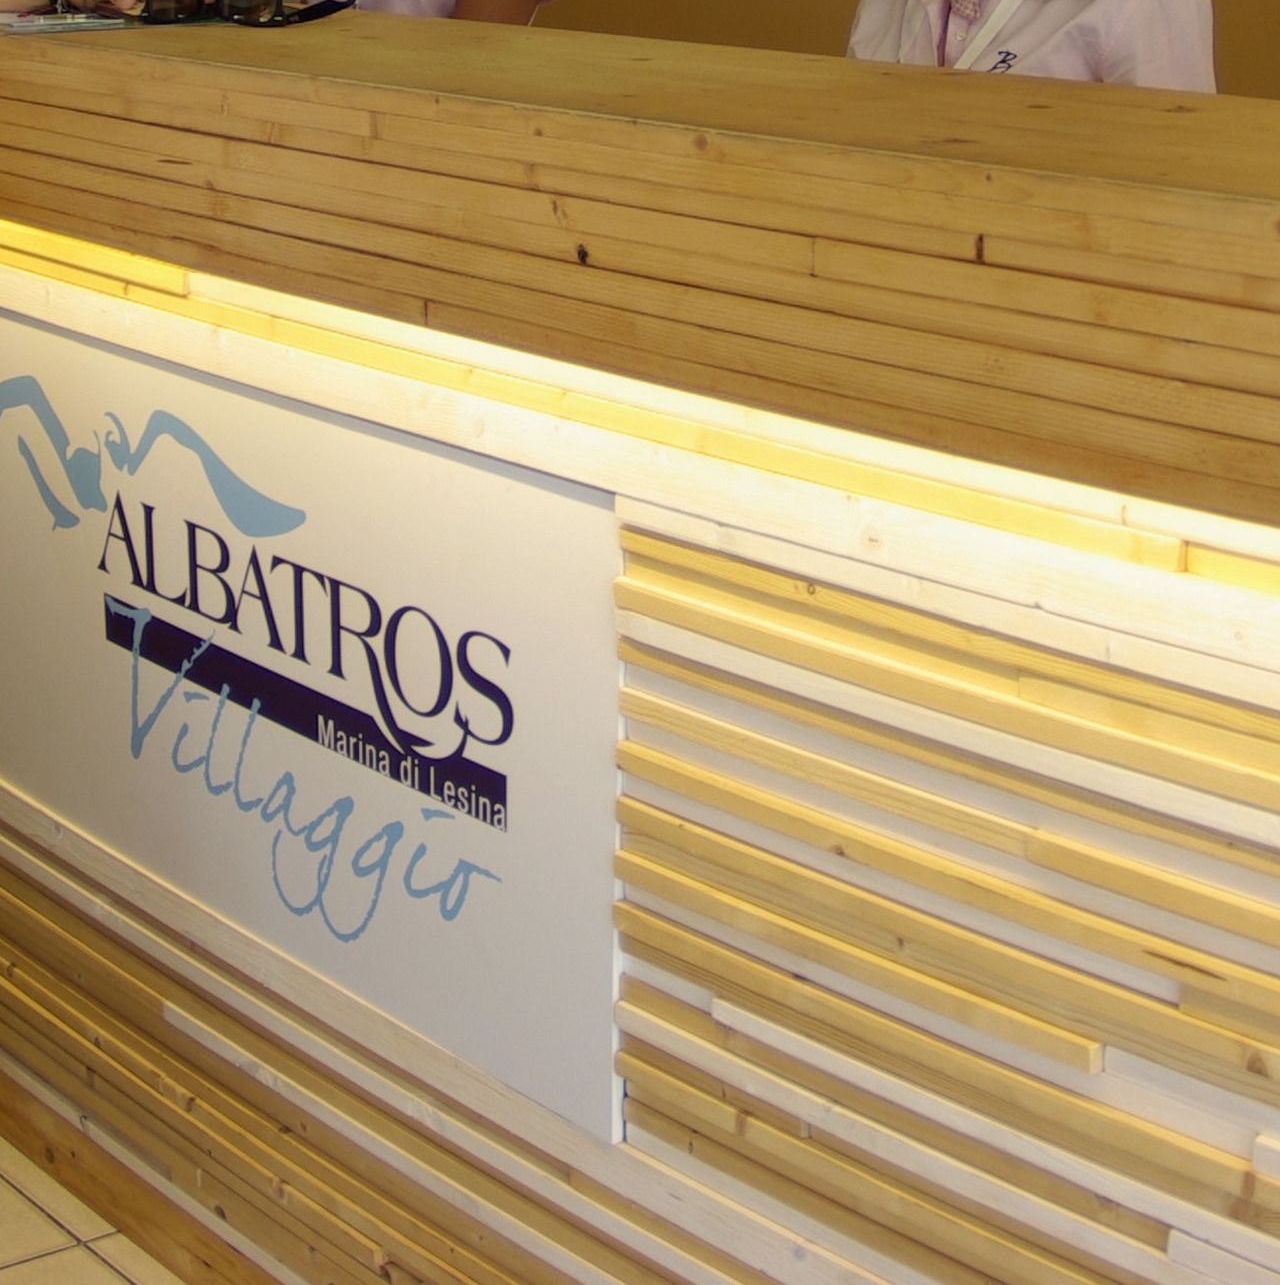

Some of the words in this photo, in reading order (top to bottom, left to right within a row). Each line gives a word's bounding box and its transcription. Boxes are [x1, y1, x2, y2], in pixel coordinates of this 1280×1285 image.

[97, 489, 514, 747] ALBATROS
[104, 593, 503, 943] Villaggio
[317, 714, 391, 778] Marina
[400, 755, 421, 792] di
[429, 766, 508, 832] Lesina
